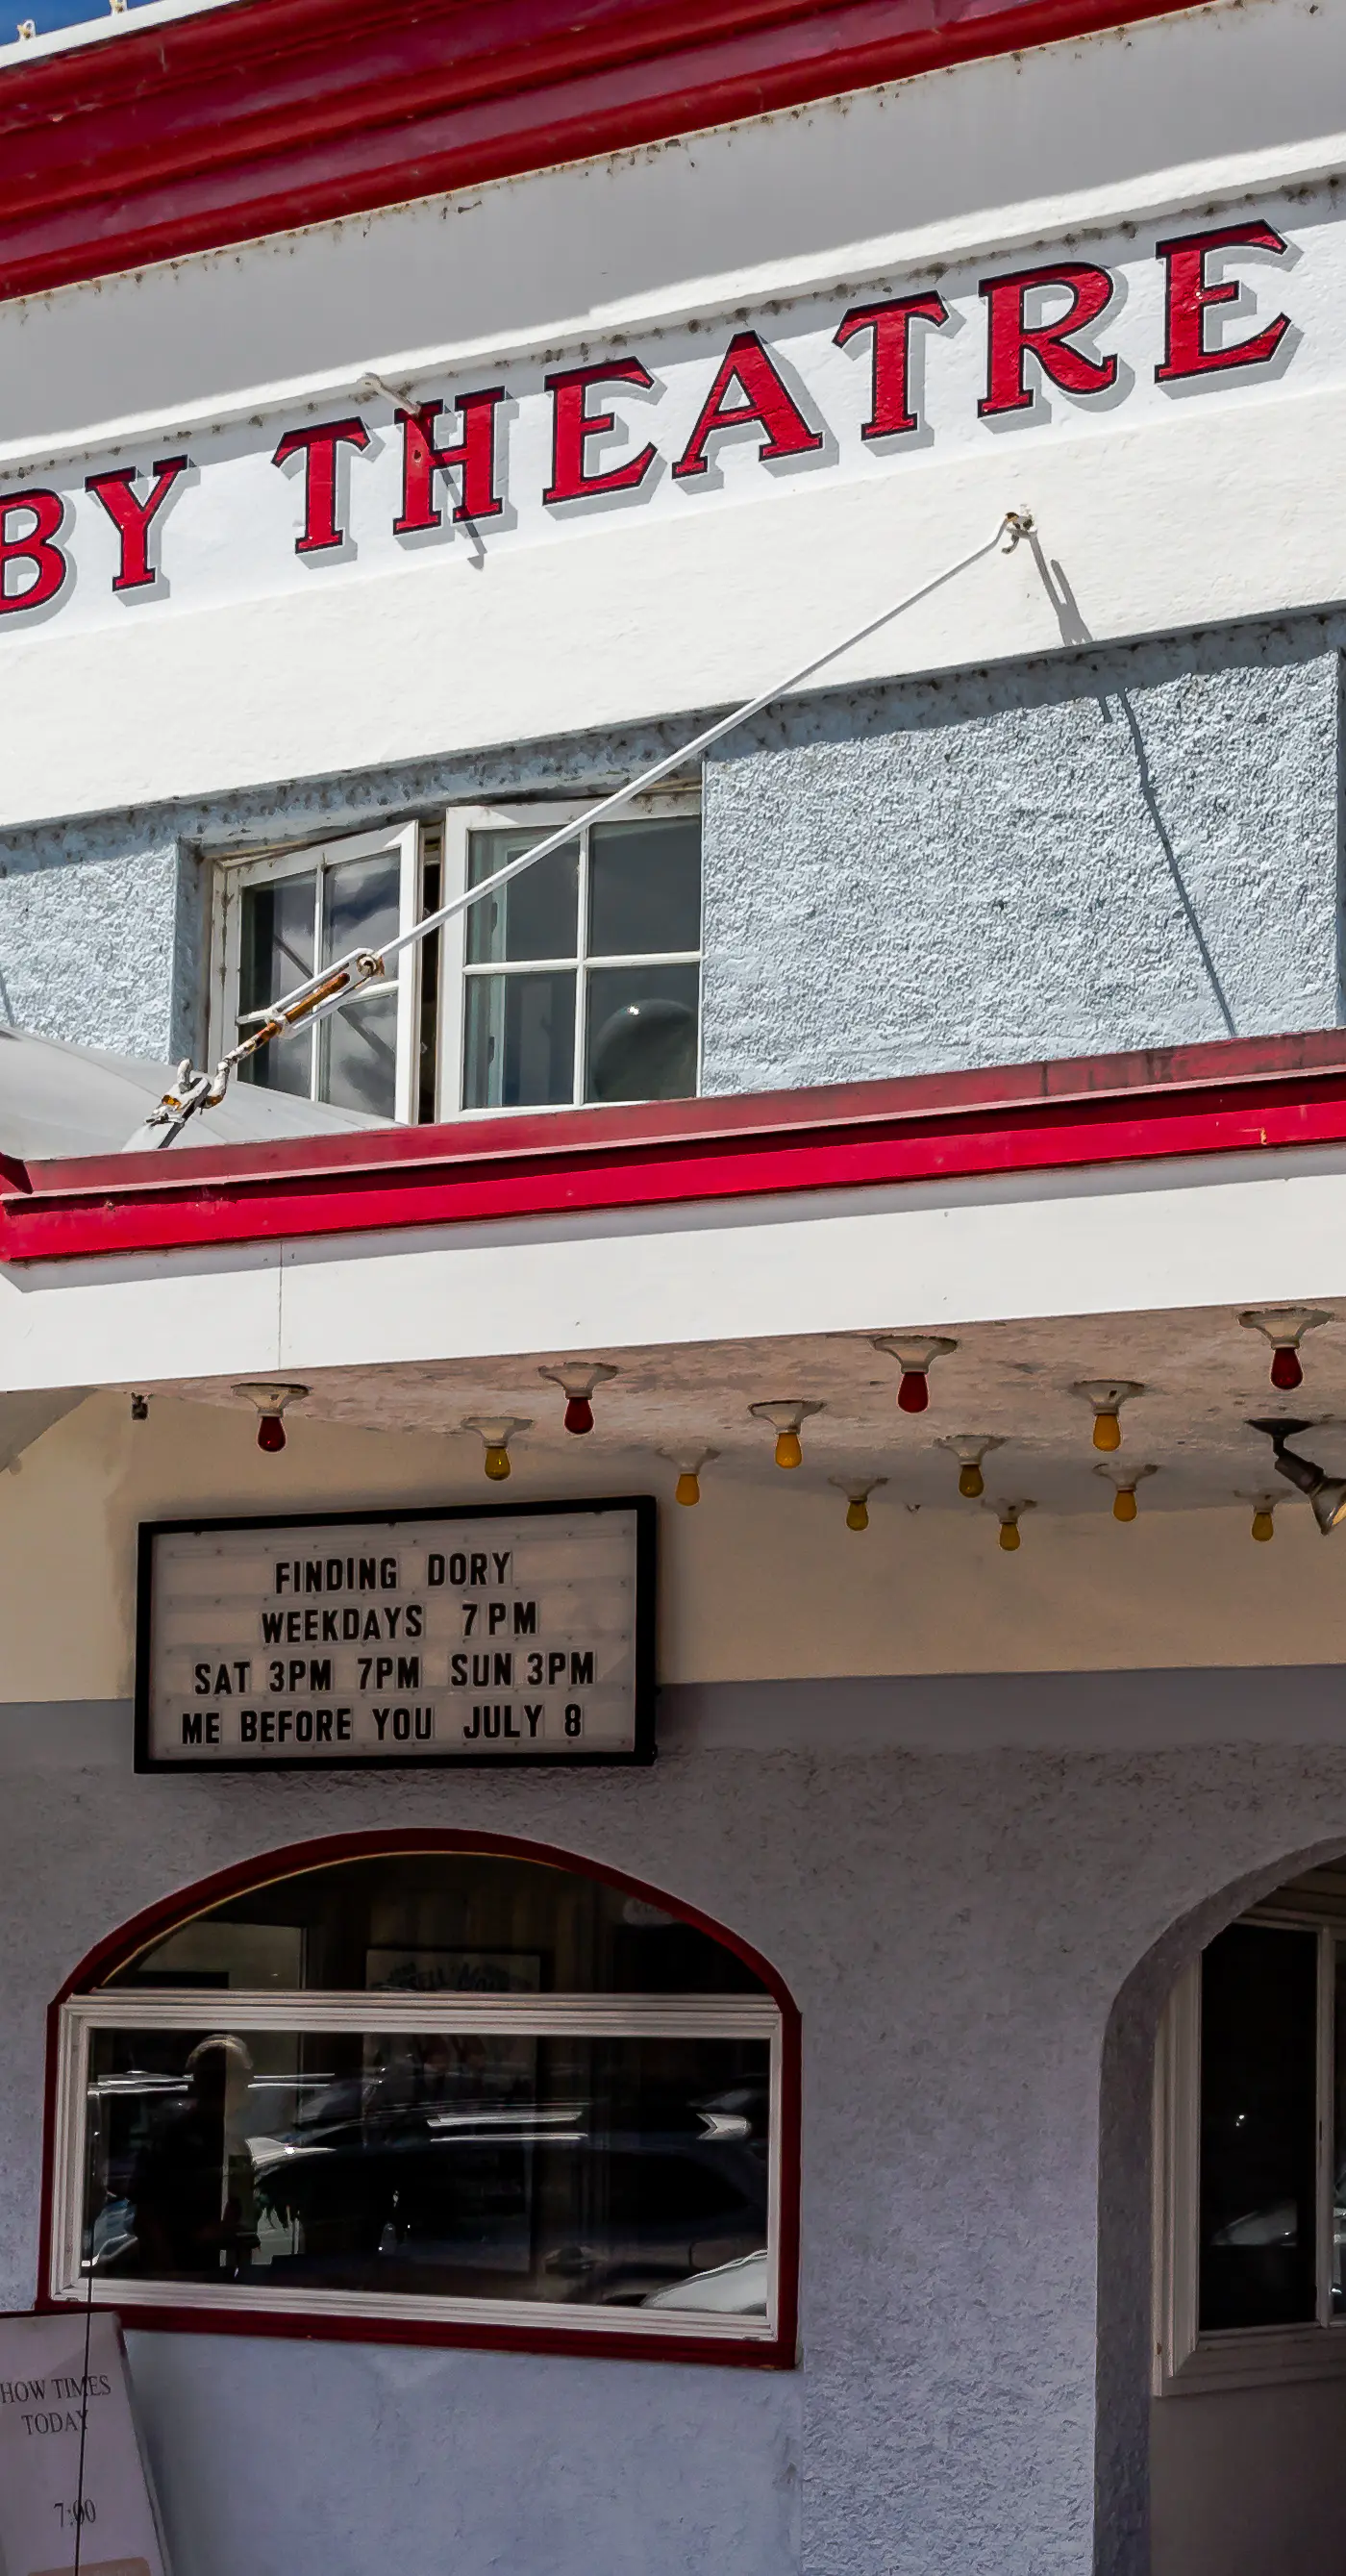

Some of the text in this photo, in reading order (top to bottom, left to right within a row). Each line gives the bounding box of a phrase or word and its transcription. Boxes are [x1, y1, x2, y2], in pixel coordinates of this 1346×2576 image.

[0, 219, 1291, 614] BY THEATRE
[276, 1552, 511, 1594] FINDING DORY
[262, 1605, 422, 1643] WEEKDAYS
[194, 1652, 594, 1695] SAT 3PM 7PM SUN 3PM
[182, 1704, 582, 1744] ME BEFORE YOU JULY 8
[51, 2375, 112, 2399] TIMES
[21, 2410, 88, 2436] TODAY
[54, 2499, 96, 2528] 7:00
